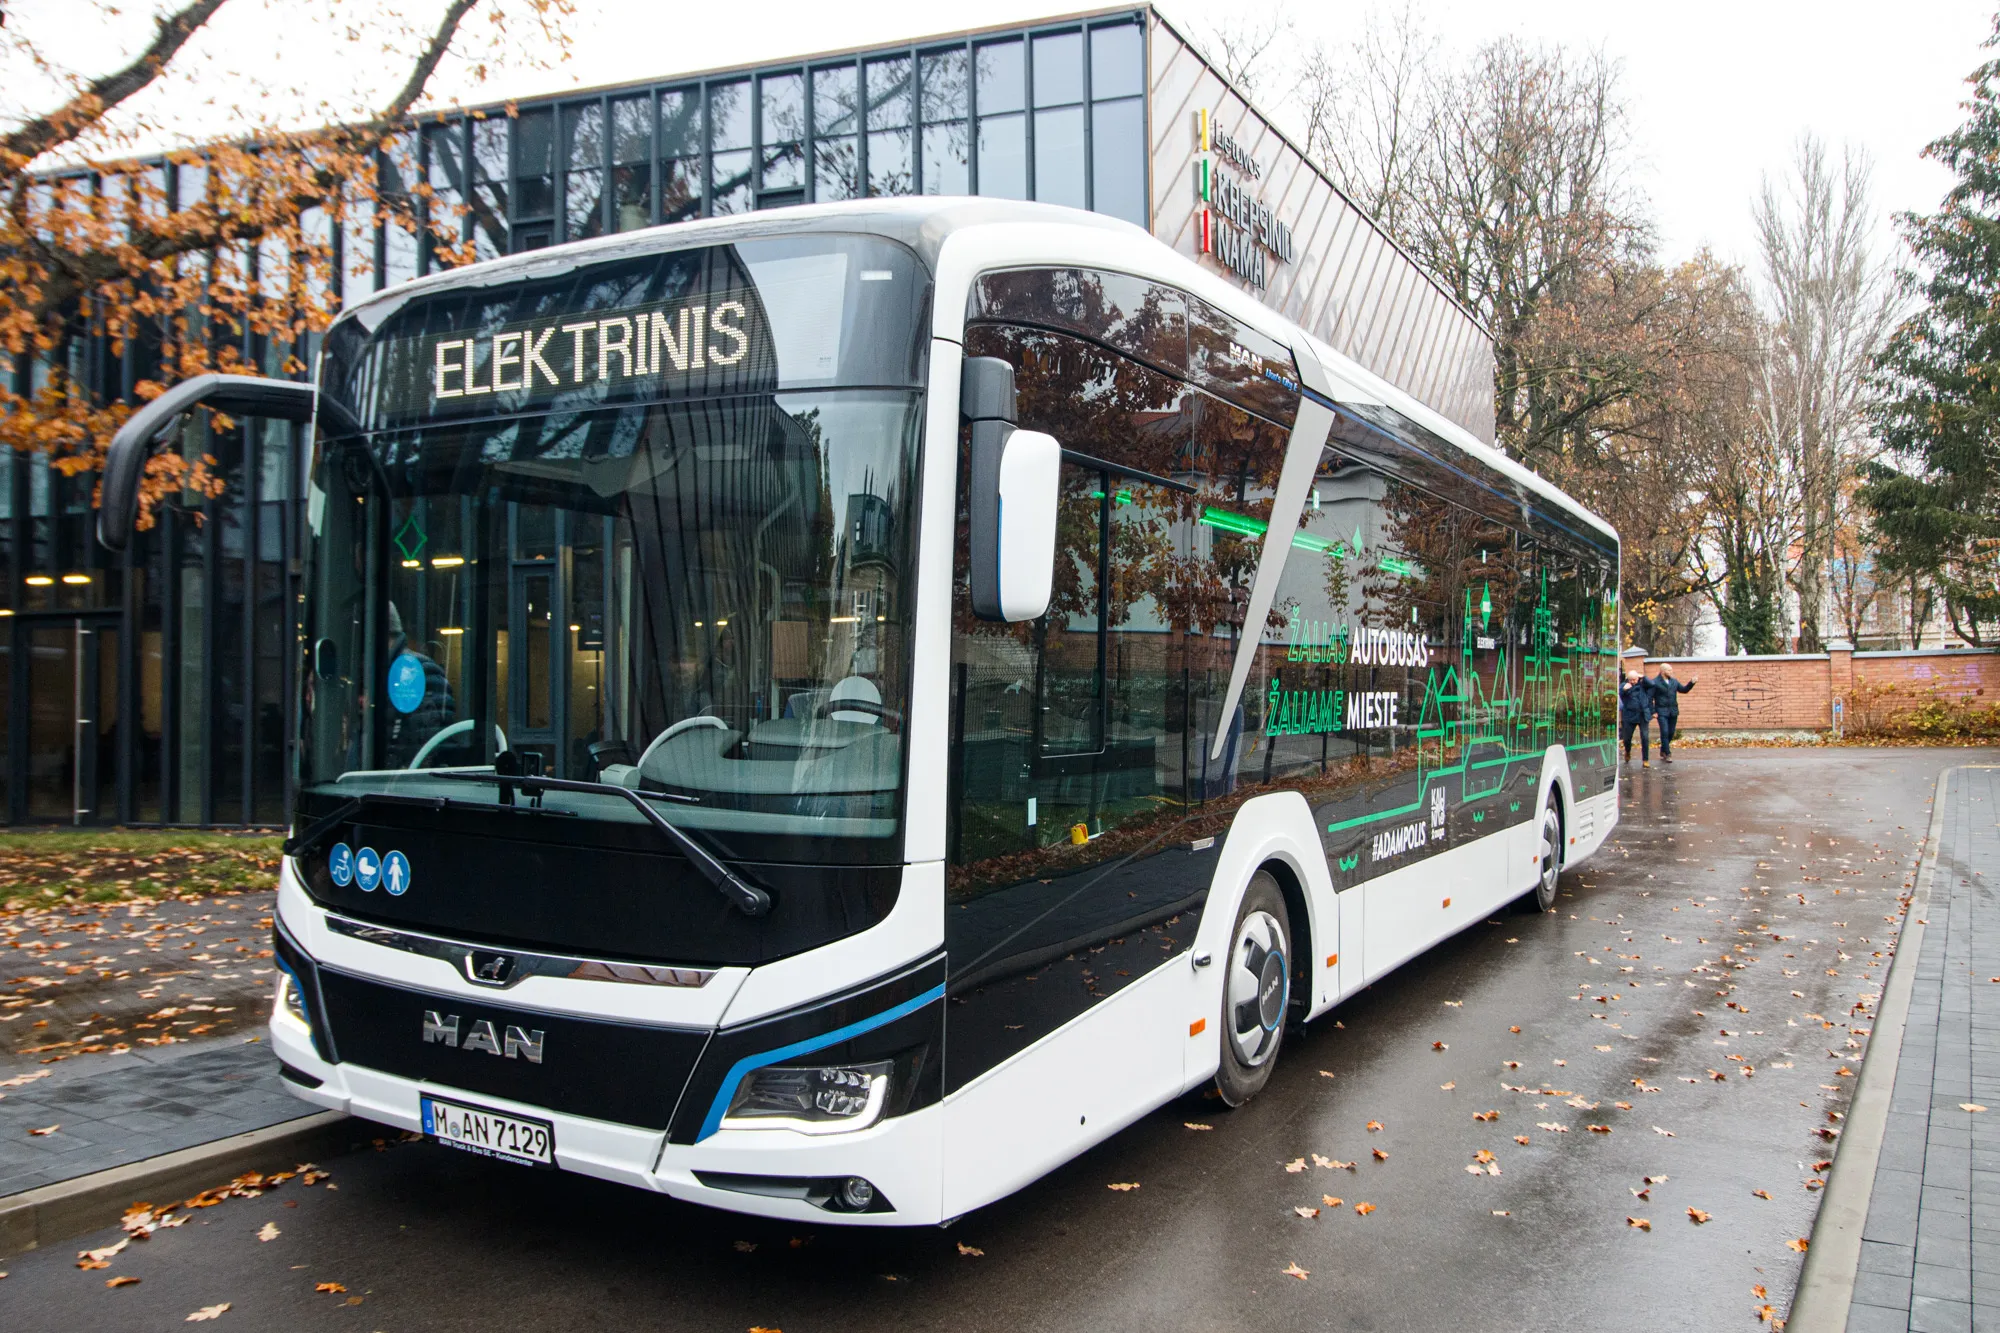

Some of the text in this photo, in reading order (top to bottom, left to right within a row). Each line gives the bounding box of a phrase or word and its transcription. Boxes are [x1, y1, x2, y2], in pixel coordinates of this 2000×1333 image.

[1214, 119, 1261, 180] Lietuvos
[1215, 168, 1292, 264] KREPŠINIO
[1216, 218, 1265, 290] NAMAI
[436, 301, 748, 399] ELEKTRINIS
[1229, 342, 1263, 374] MAN
[1350, 626, 1428, 667] AUTOBUSAS
[1266, 678, 1398, 737] ŽALIAME MIESTE
[1372, 820, 1426, 862] #ADAMPOLIS
[1261, 976, 1279, 1005] MAN
[423, 1010, 544, 1064] MAN
[494, 1118, 548, 1157] 7129
